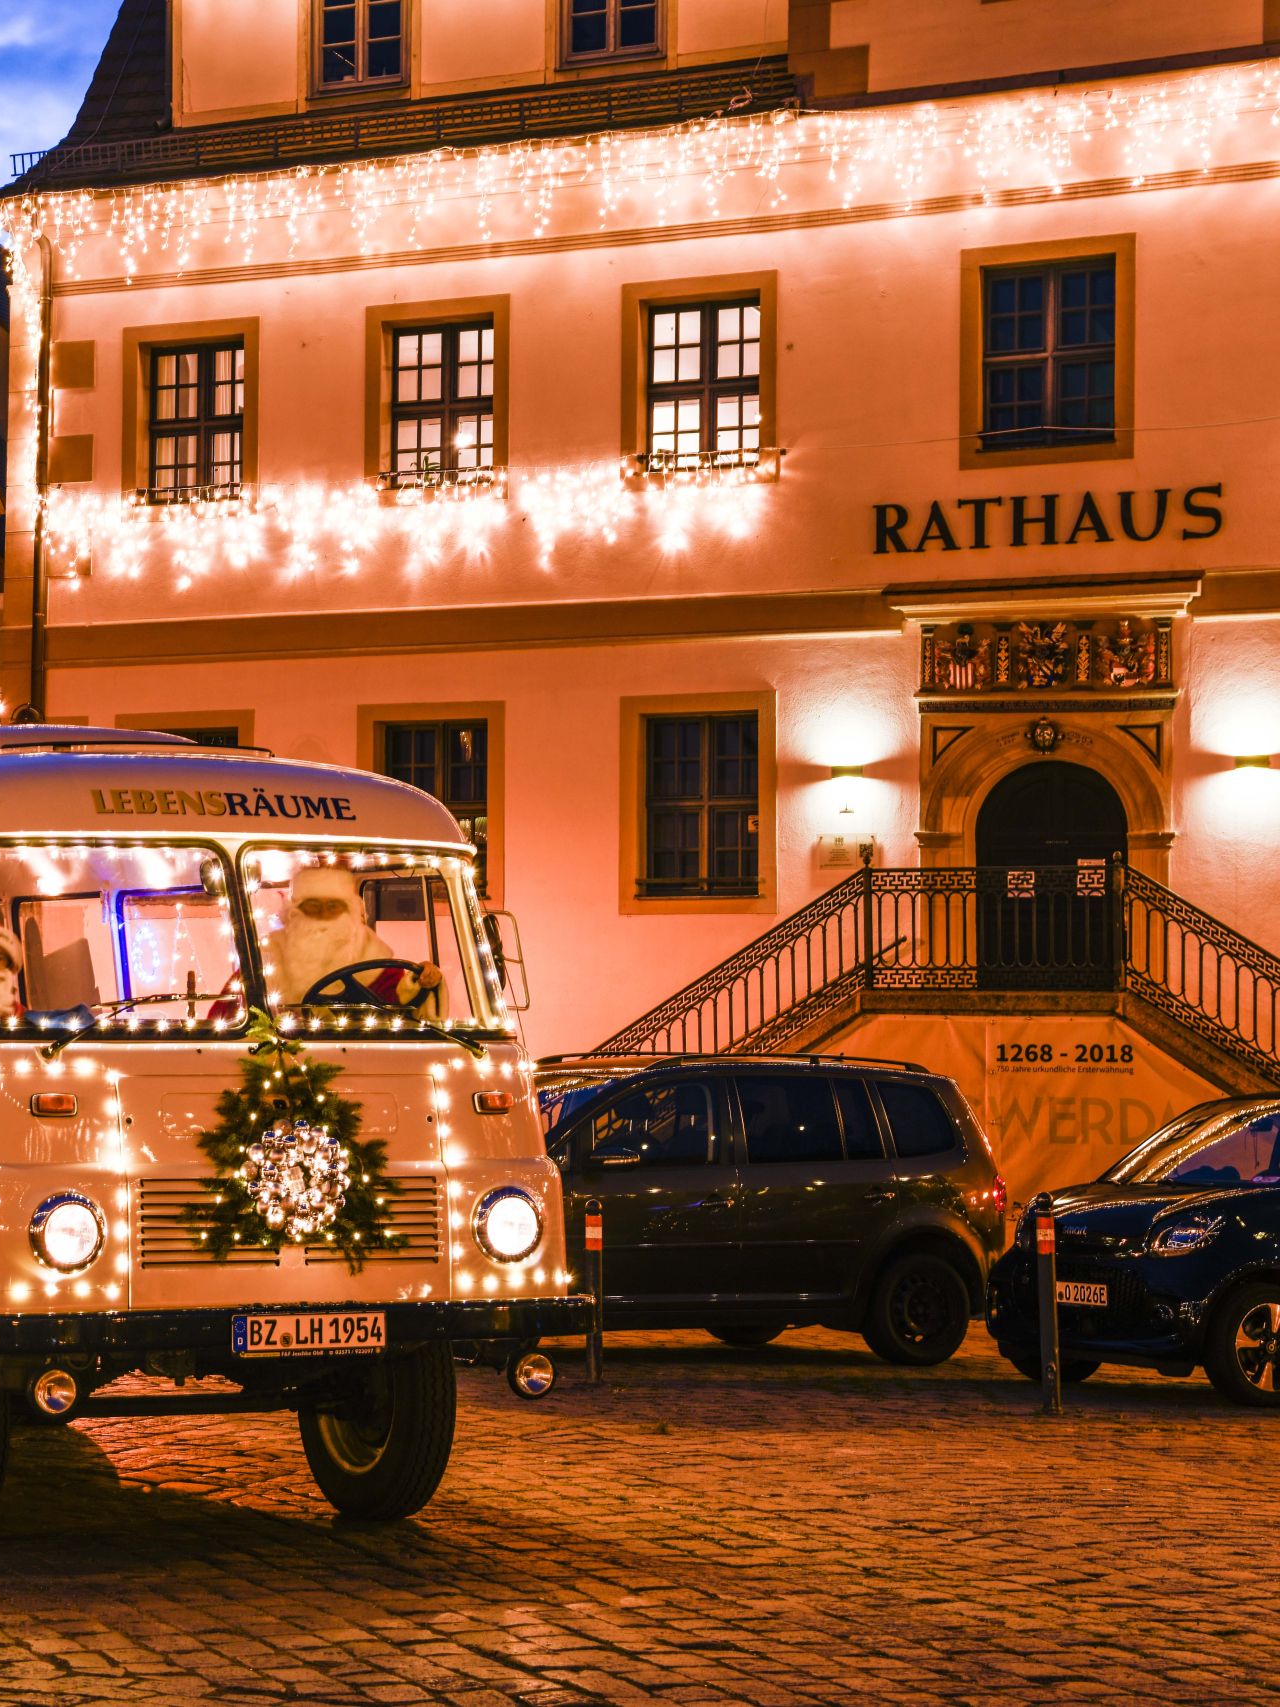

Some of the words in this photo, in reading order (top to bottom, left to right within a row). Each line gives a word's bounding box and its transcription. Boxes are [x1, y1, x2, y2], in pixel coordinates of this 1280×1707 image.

[872, 482, 1223, 555] RATHAUS
[90, 787, 357, 821] LEBENSRÄUME
[996, 1044, 1053, 1063] 1268
[1075, 1044, 1134, 1063] 2018
[997, 1065, 1009, 1073] 750
[1010, 1065, 1032, 1073] Jahre
[1032, 1065, 1076, 1073] urkundliche
[1077, 1065, 1134, 1076] Ersterwähnung
[1061, 1224, 1088, 1236] smart
[1073, 1284, 1107, 1304] 2026E
[249, 1319, 278, 1346] BZ
[295, 1318, 323, 1345] LH
[329, 1316, 383, 1344] 1954
